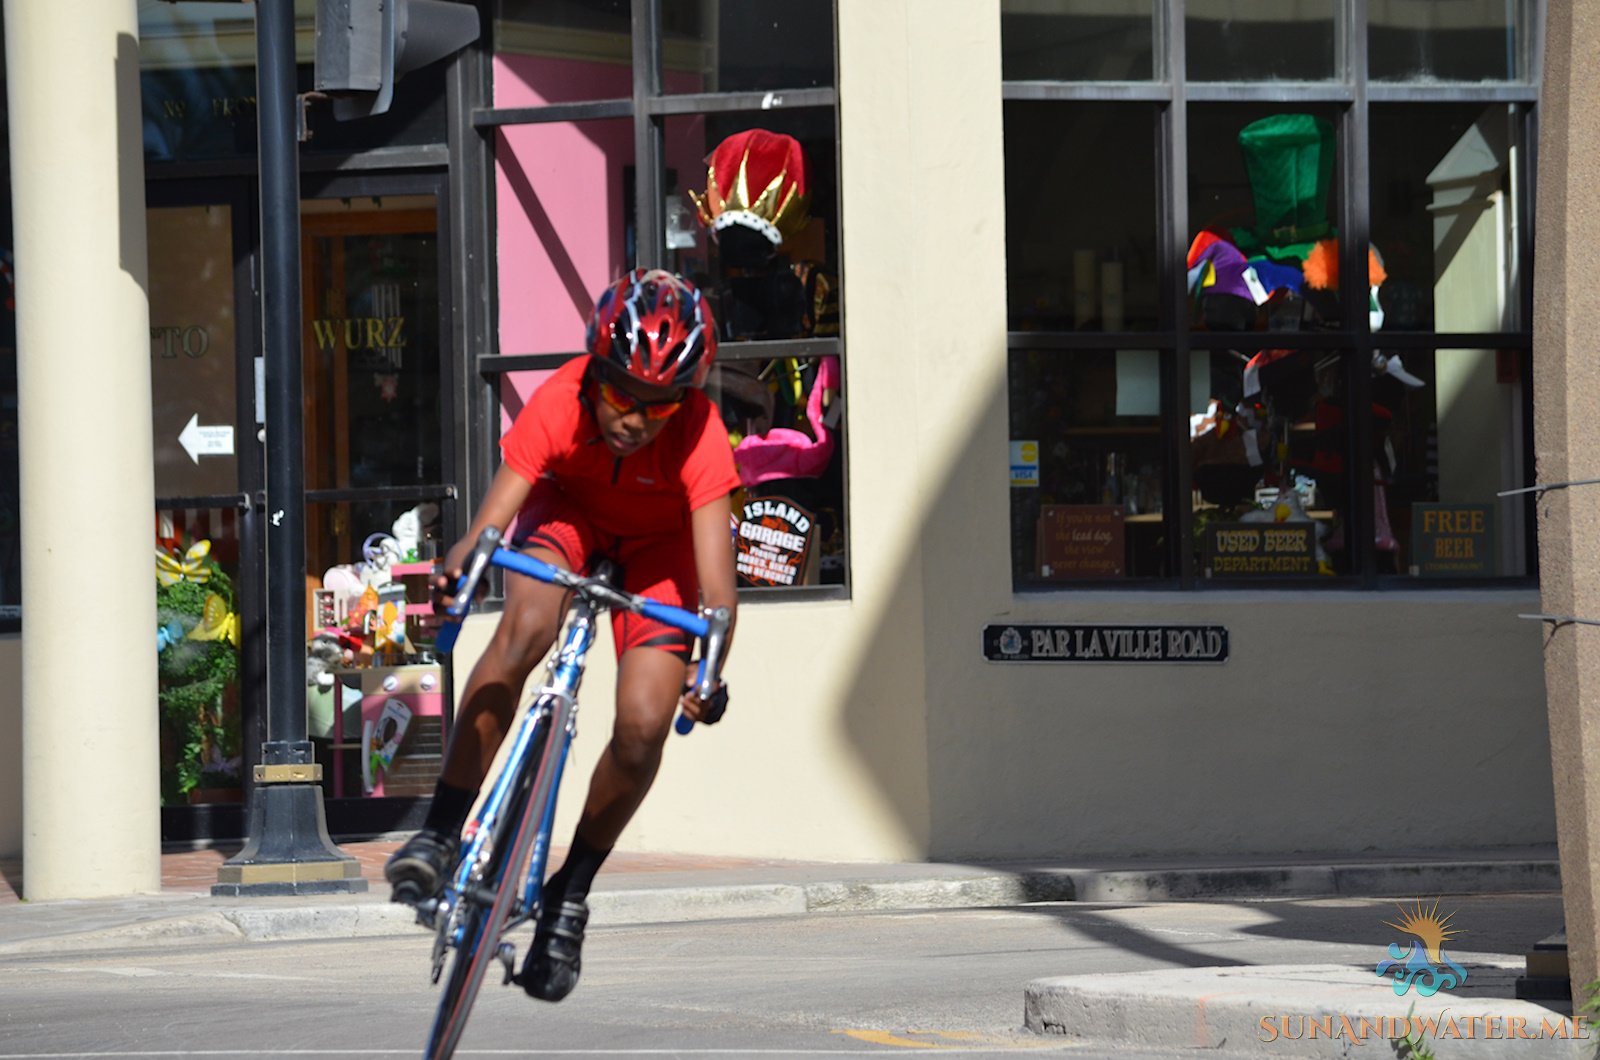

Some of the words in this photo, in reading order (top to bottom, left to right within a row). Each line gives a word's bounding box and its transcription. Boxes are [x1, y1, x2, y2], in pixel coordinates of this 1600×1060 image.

[310, 315, 407, 351] WURZ
[743, 501, 810, 533] ISLAND
[1424, 510, 1485, 533] FREE
[739, 520, 806, 554] GARAGE
[1072, 528, 1092, 542] lead
[1216, 529, 1261, 553] USED
[1264, 529, 1308, 553] BEER
[1435, 538, 1474, 559] BEER
[1213, 556, 1313, 573] DEPARTMENT
[1031, 629, 1071, 658] PAR
[1166, 629, 1223, 658] ROAD
